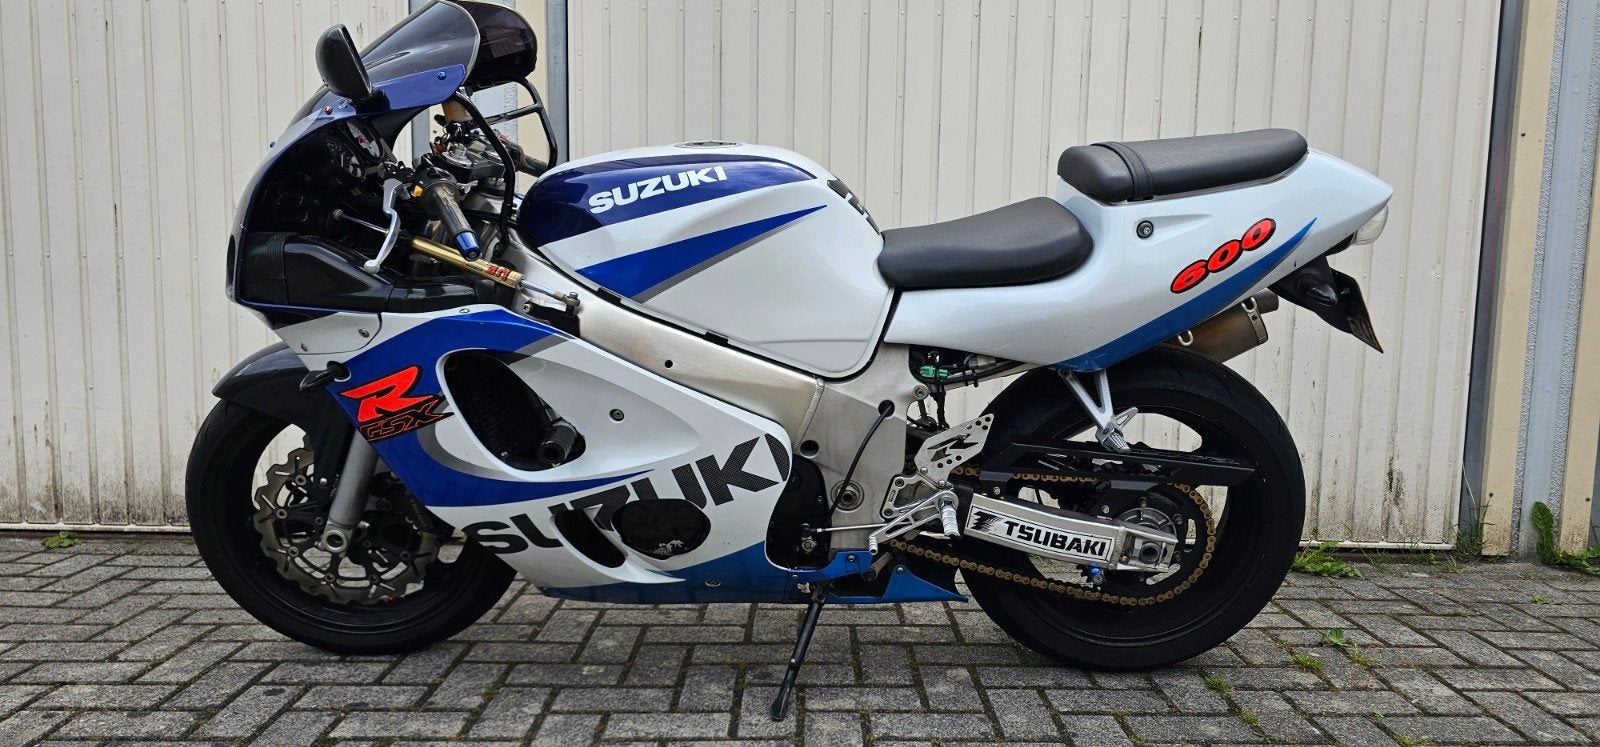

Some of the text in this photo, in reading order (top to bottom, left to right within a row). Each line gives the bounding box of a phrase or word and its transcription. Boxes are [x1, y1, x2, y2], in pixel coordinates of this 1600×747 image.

[588, 166, 728, 214] SUZUKI
[1170, 218, 1276, 294] 600
[339, 365, 434, 423] R
[1004, 520, 1106, 557] TSUBAKI
